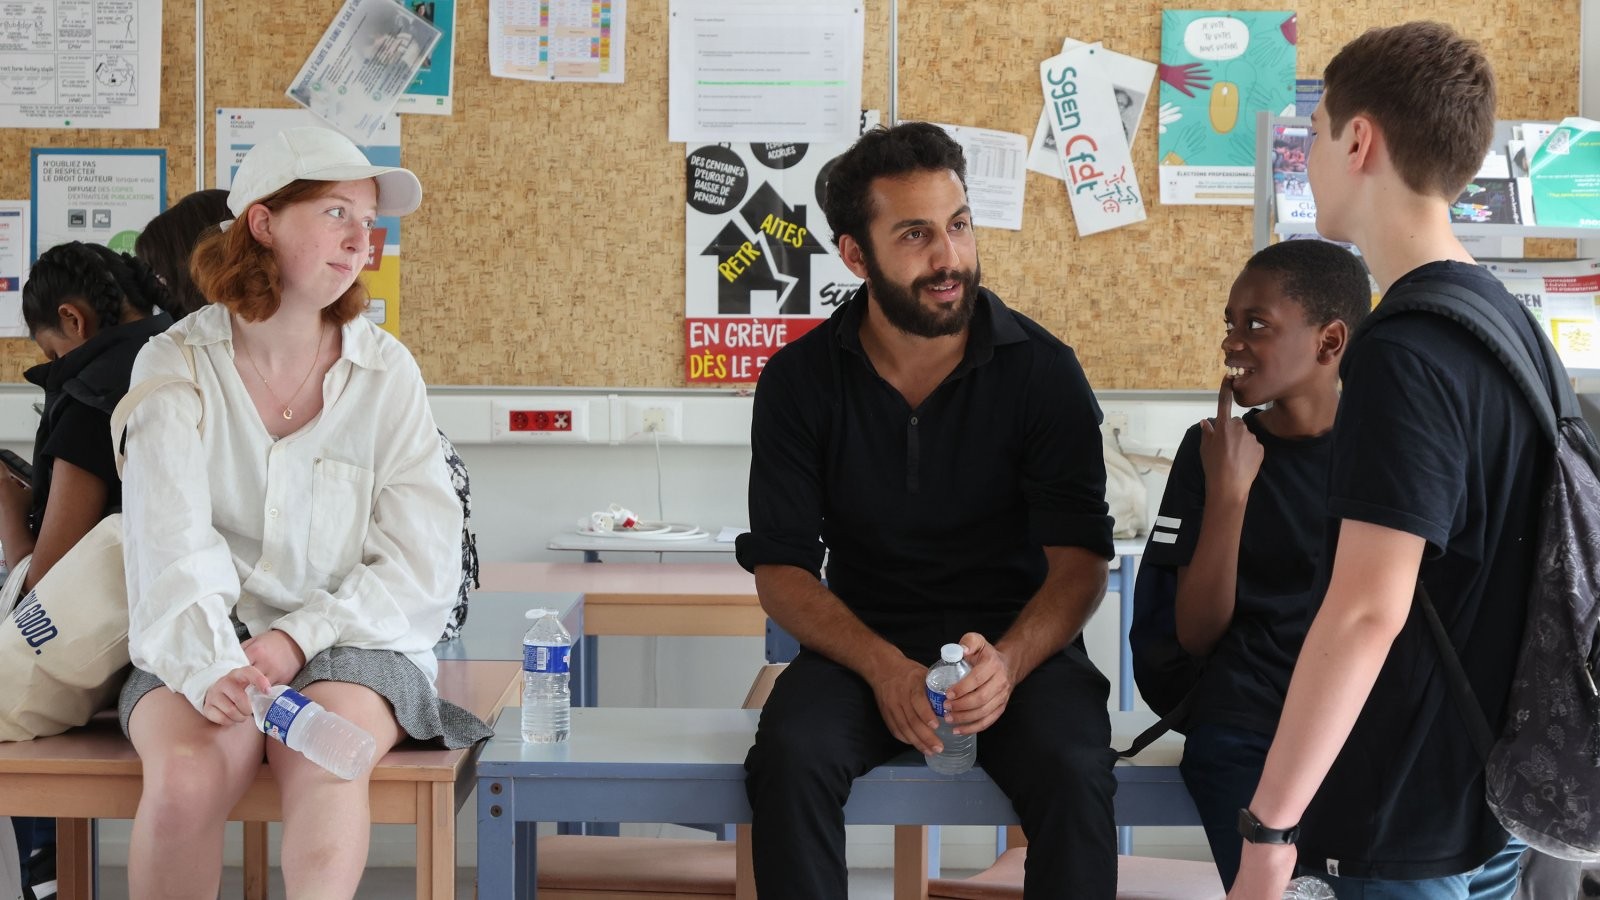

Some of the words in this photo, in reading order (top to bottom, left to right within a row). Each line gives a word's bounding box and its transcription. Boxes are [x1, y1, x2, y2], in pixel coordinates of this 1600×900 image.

[690, 155, 703, 166] DES
[705, 159, 745, 177] CENTAINES
[694, 168, 724, 183] D'EUROS
[725, 176, 736, 186] DE
[693, 192, 726, 206] PENSION
[694, 179, 719, 193] BAISSE
[719, 187, 731, 196] DE
[760, 213, 807, 248] AITES
[718, 241, 761, 283] RETR
[689, 322, 719, 348] EN
[725, 318, 788, 348] GRÈVE
[690, 350, 727, 379] DÈS
[731, 356, 752, 378] LE
